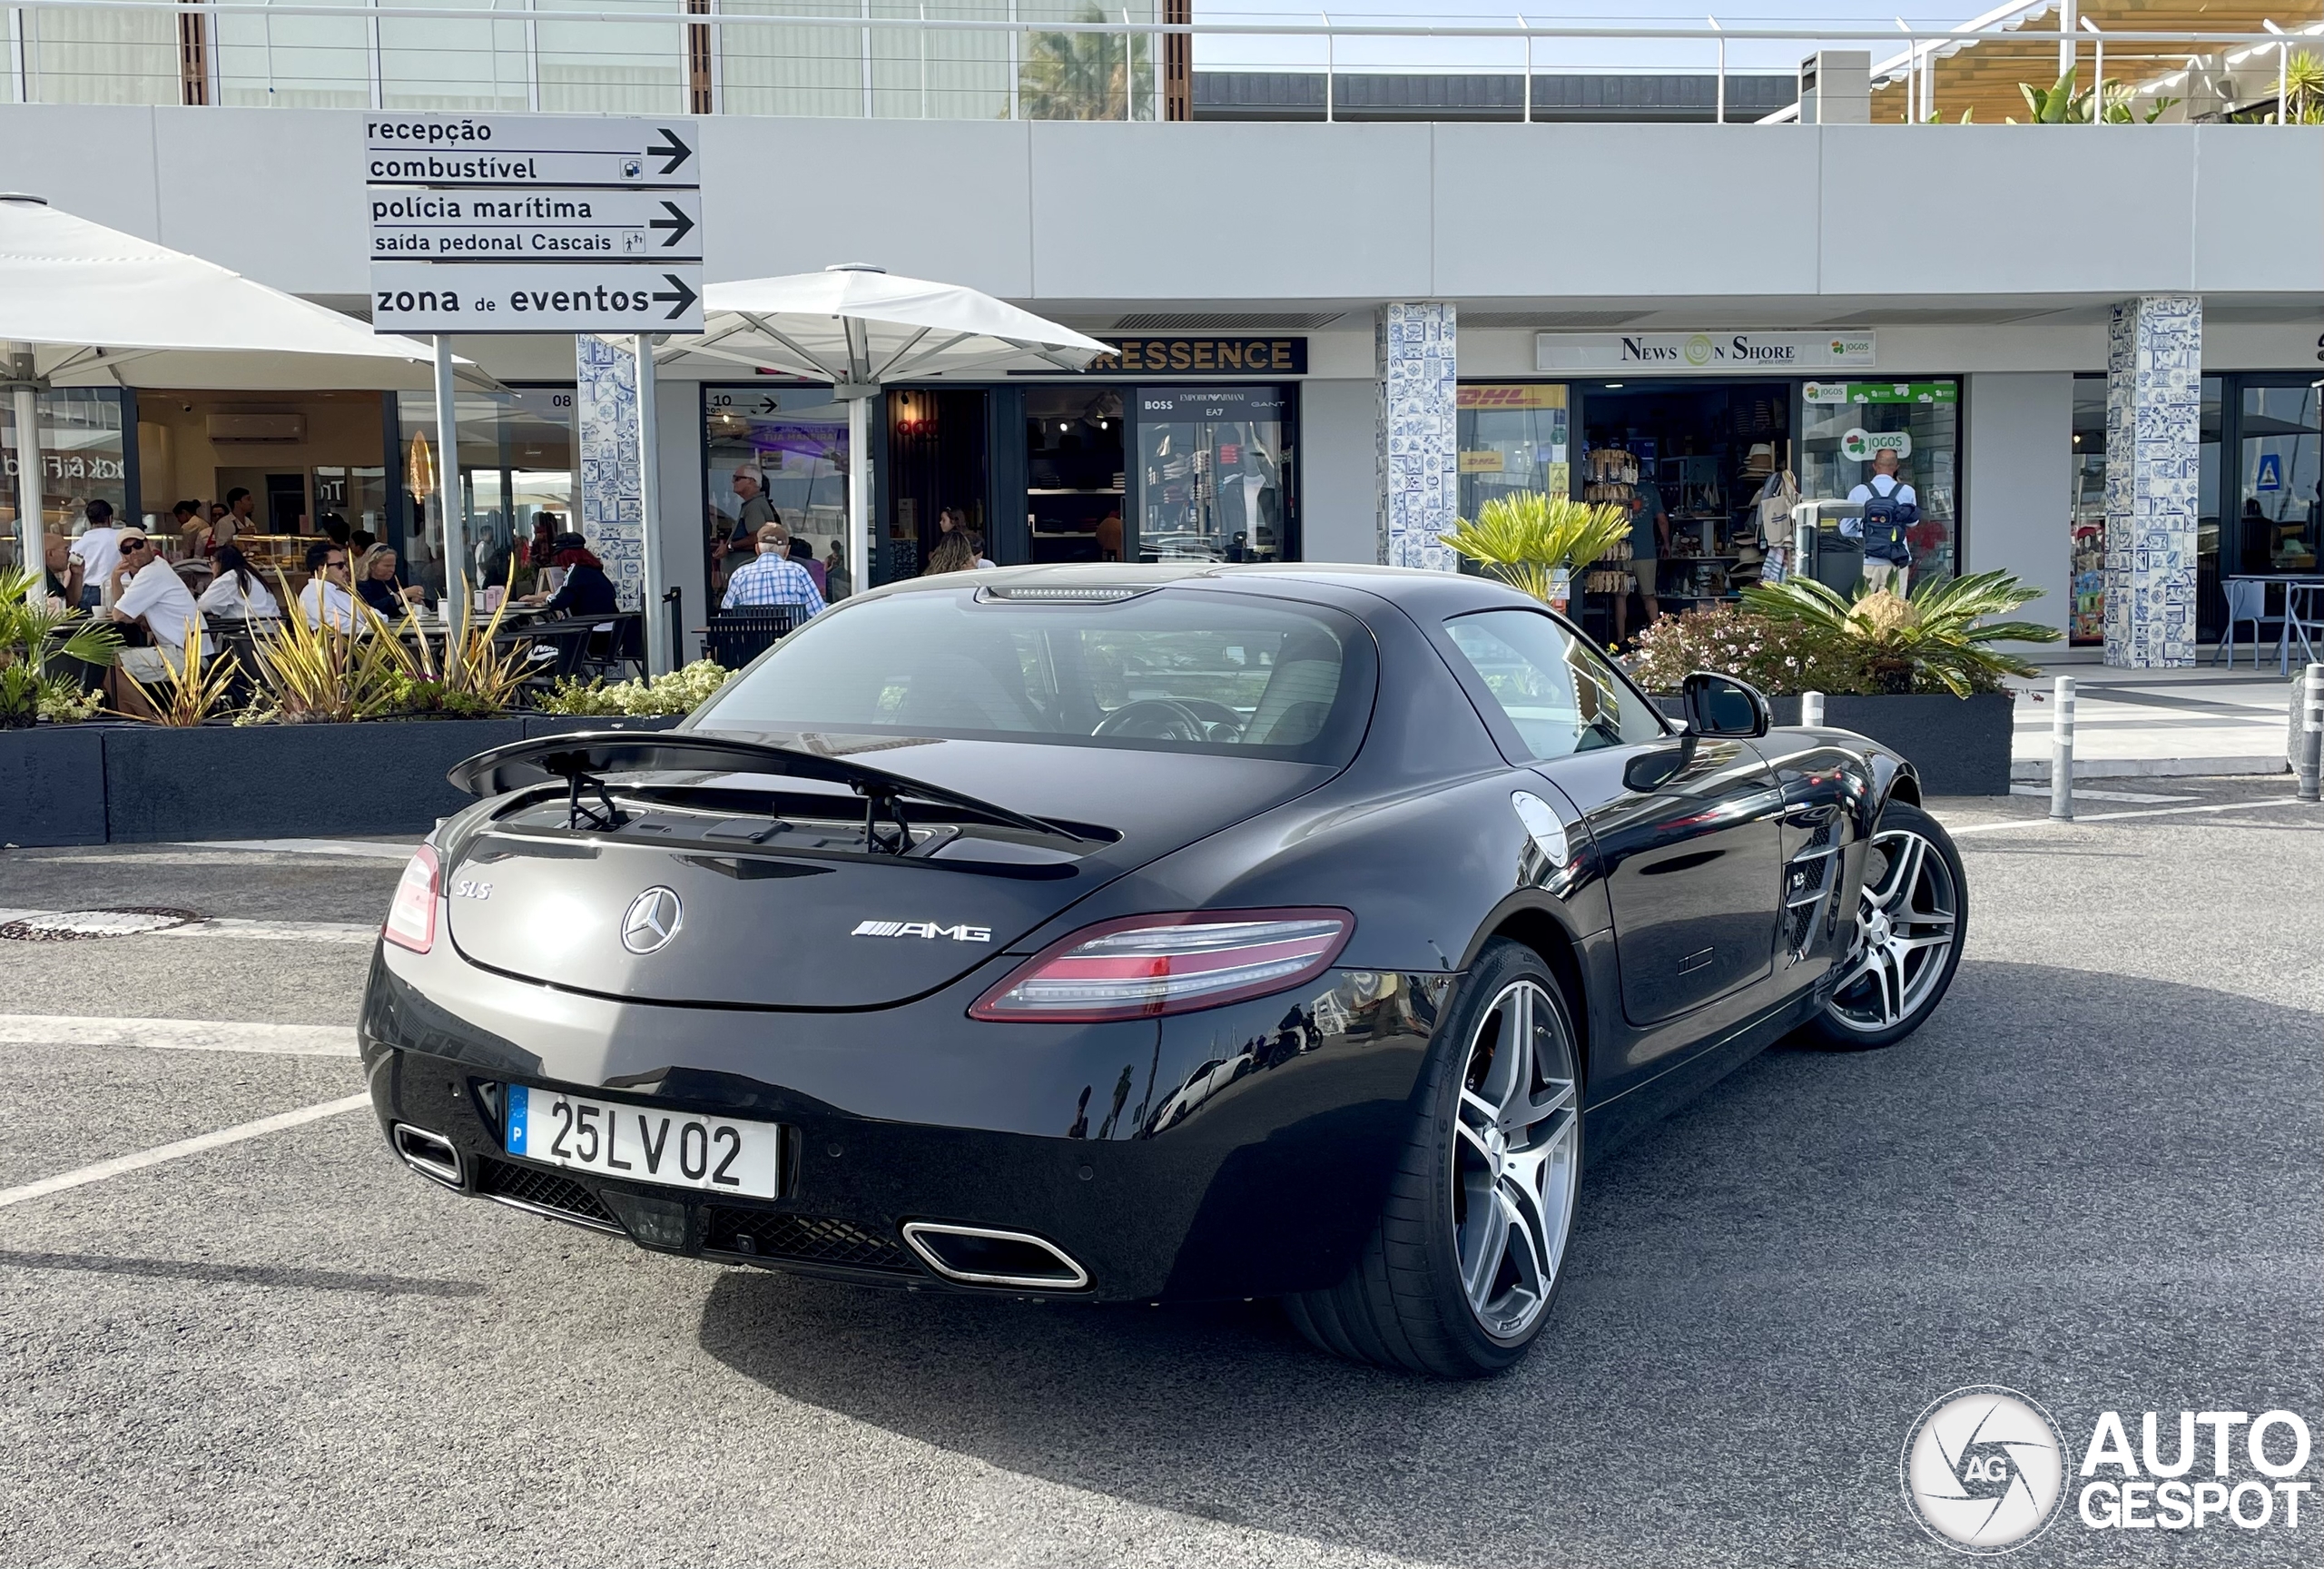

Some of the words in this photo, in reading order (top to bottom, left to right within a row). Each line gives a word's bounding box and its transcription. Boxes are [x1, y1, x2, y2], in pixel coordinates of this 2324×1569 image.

[368, 120, 491, 146] recepção
[369, 156, 537, 179] combustível
[372, 197, 461, 221] polícia
[473, 197, 592, 218] marítima
[375, 232, 430, 251] saída
[439, 233, 523, 252] pedonal
[531, 233, 611, 251] Cascais
[377, 290, 460, 311] zona
[475, 297, 496, 311] de
[510, 284, 649, 312] eventos
[1846, 342, 1869, 352] JOGOS
[552, 395, 571, 407] 08
[714, 395, 732, 407] 10
[1456, 389, 1527, 405] DHL
[1820, 389, 1843, 397] JOGOS
[1145, 400, 1173, 410] BOSS
[1868, 436, 1903, 451] JOGOS
[456, 880, 493, 900] SLS
[894, 922, 991, 942] AMG
[513, 1127, 522, 1142] P
